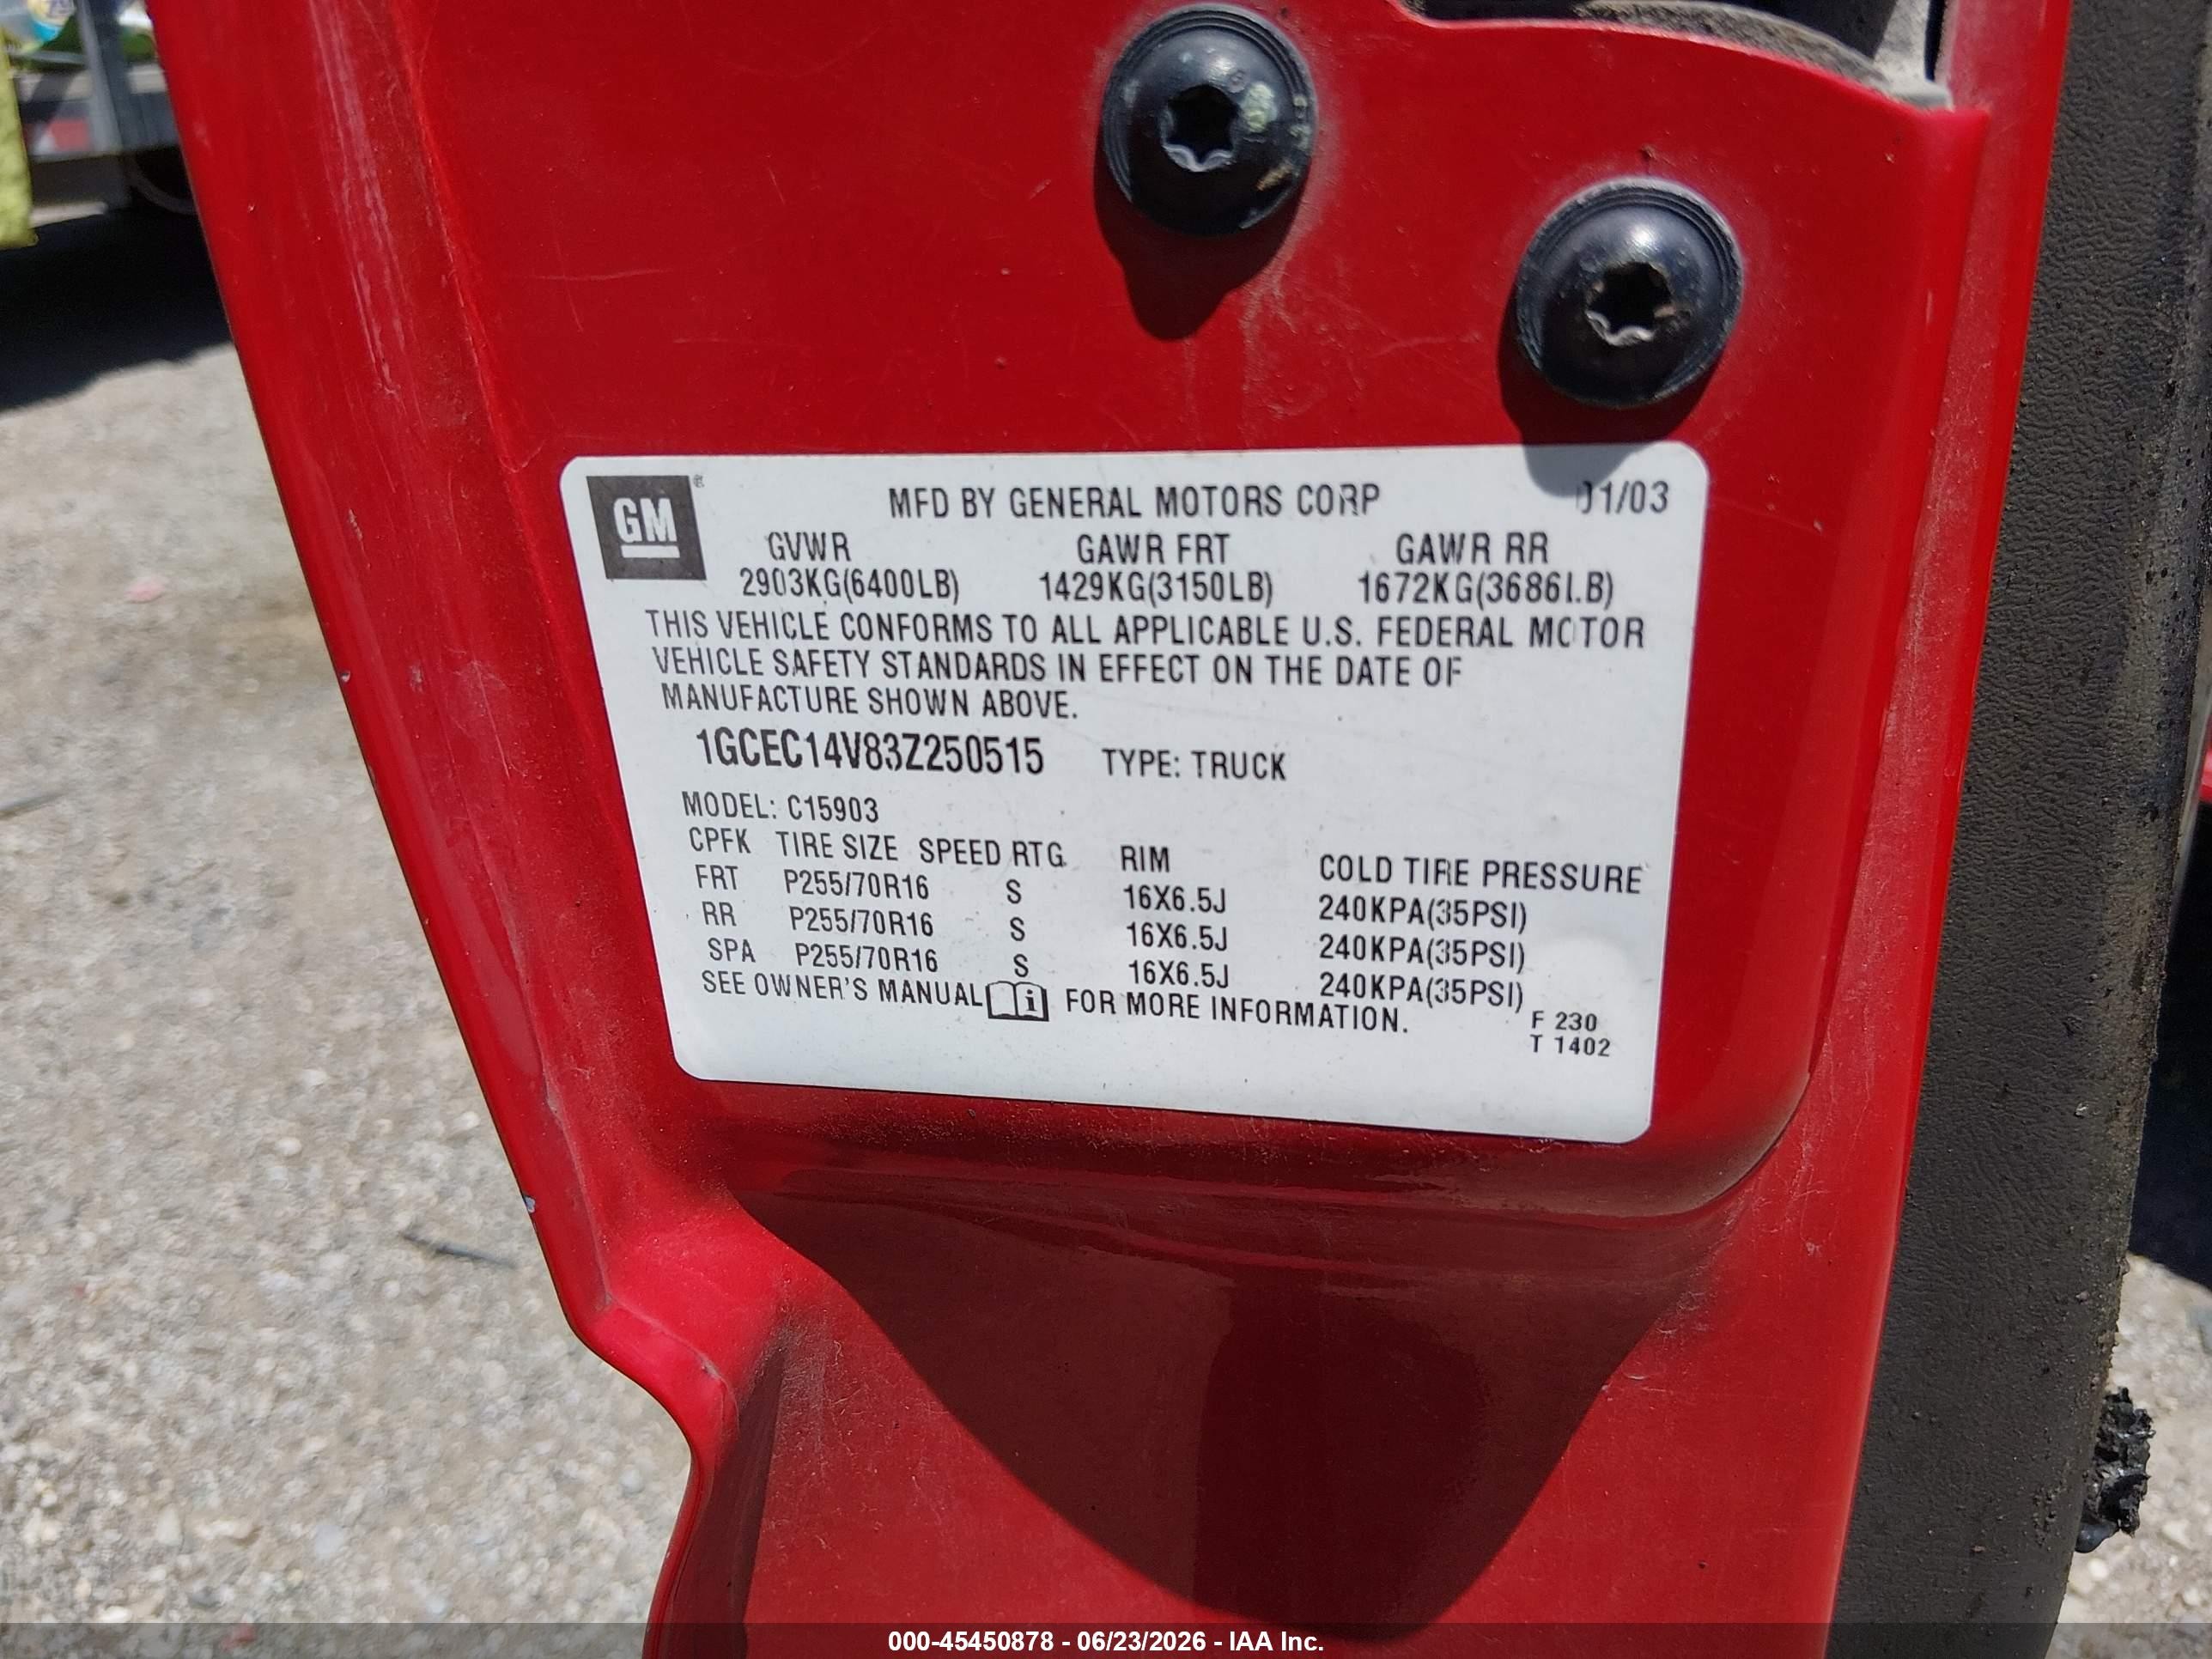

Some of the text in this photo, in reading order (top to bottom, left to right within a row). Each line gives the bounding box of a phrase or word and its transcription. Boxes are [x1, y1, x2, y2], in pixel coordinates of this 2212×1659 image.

[888, 483, 1381, 520] MFD BY GENERAL MOTORS CORP
[614, 497, 678, 543] GM
[765, 531, 853, 562] GVWR
[1076, 532, 1231, 566] GAWR FRT
[1395, 531, 1549, 566] GAWR RR
[739, 567, 960, 602] 2903KG(6400LB)
[1038, 569, 1273, 610] 1429KG(3150LB)
[644, 609, 1644, 649] THIS VEHICLE CONFORMS TO ALL APPLICABLE U.S. FEDERAL MOTOR
[651, 646, 1462, 688] VEHICLE SAFETY STANDARDS IN EFFECT ON THE DATE OF
[660, 682, 1078, 720] MANUFACTURE SHOWN ABOVE.
[696, 726, 1045, 776] 1GCEC14V83Z250515
[1101, 747, 1287, 781] TYPE: TRUCK
[681, 790, 879, 824] MODEL: C15903
[688, 826, 752, 854] CPFK
[775, 830, 899, 862] TIRE SIZE
[918, 836, 1001, 866] SPEED
[1120, 844, 1170, 873] RIM
[1319, 853, 1644, 895] COLD TIRE PRESSURE
[694, 863, 739, 890] FRT
[783, 868, 930, 901] P255/70R16
[1005, 878, 1023, 905] S
[701, 900, 738, 927] RR
[1122, 883, 1226, 915] 16X6.5J
[1318, 893, 1528, 935] 240KPA(35PSI)
[788, 905, 934, 938] P255/70R16
[1009, 915, 1026, 942] S
[1126, 921, 1228, 952] 16X6.5J
[707, 937, 757, 963] SPA
[794, 942, 939, 974] P255/70R16
[1012, 952, 1030, 979] S
[1318, 932, 1525, 975] 240KPA(35PSI)
[1127, 958, 1230, 989] 16X6.5J
[701, 969, 1408, 1034] SEE OWNER'S MANUAL FOR MORE INFORMATION.
[1319, 970, 1523, 1015] 240KPA(35PSI)
[1531, 1010, 1598, 1033] F 230
[1529, 1033, 1611, 1058] T 1402
